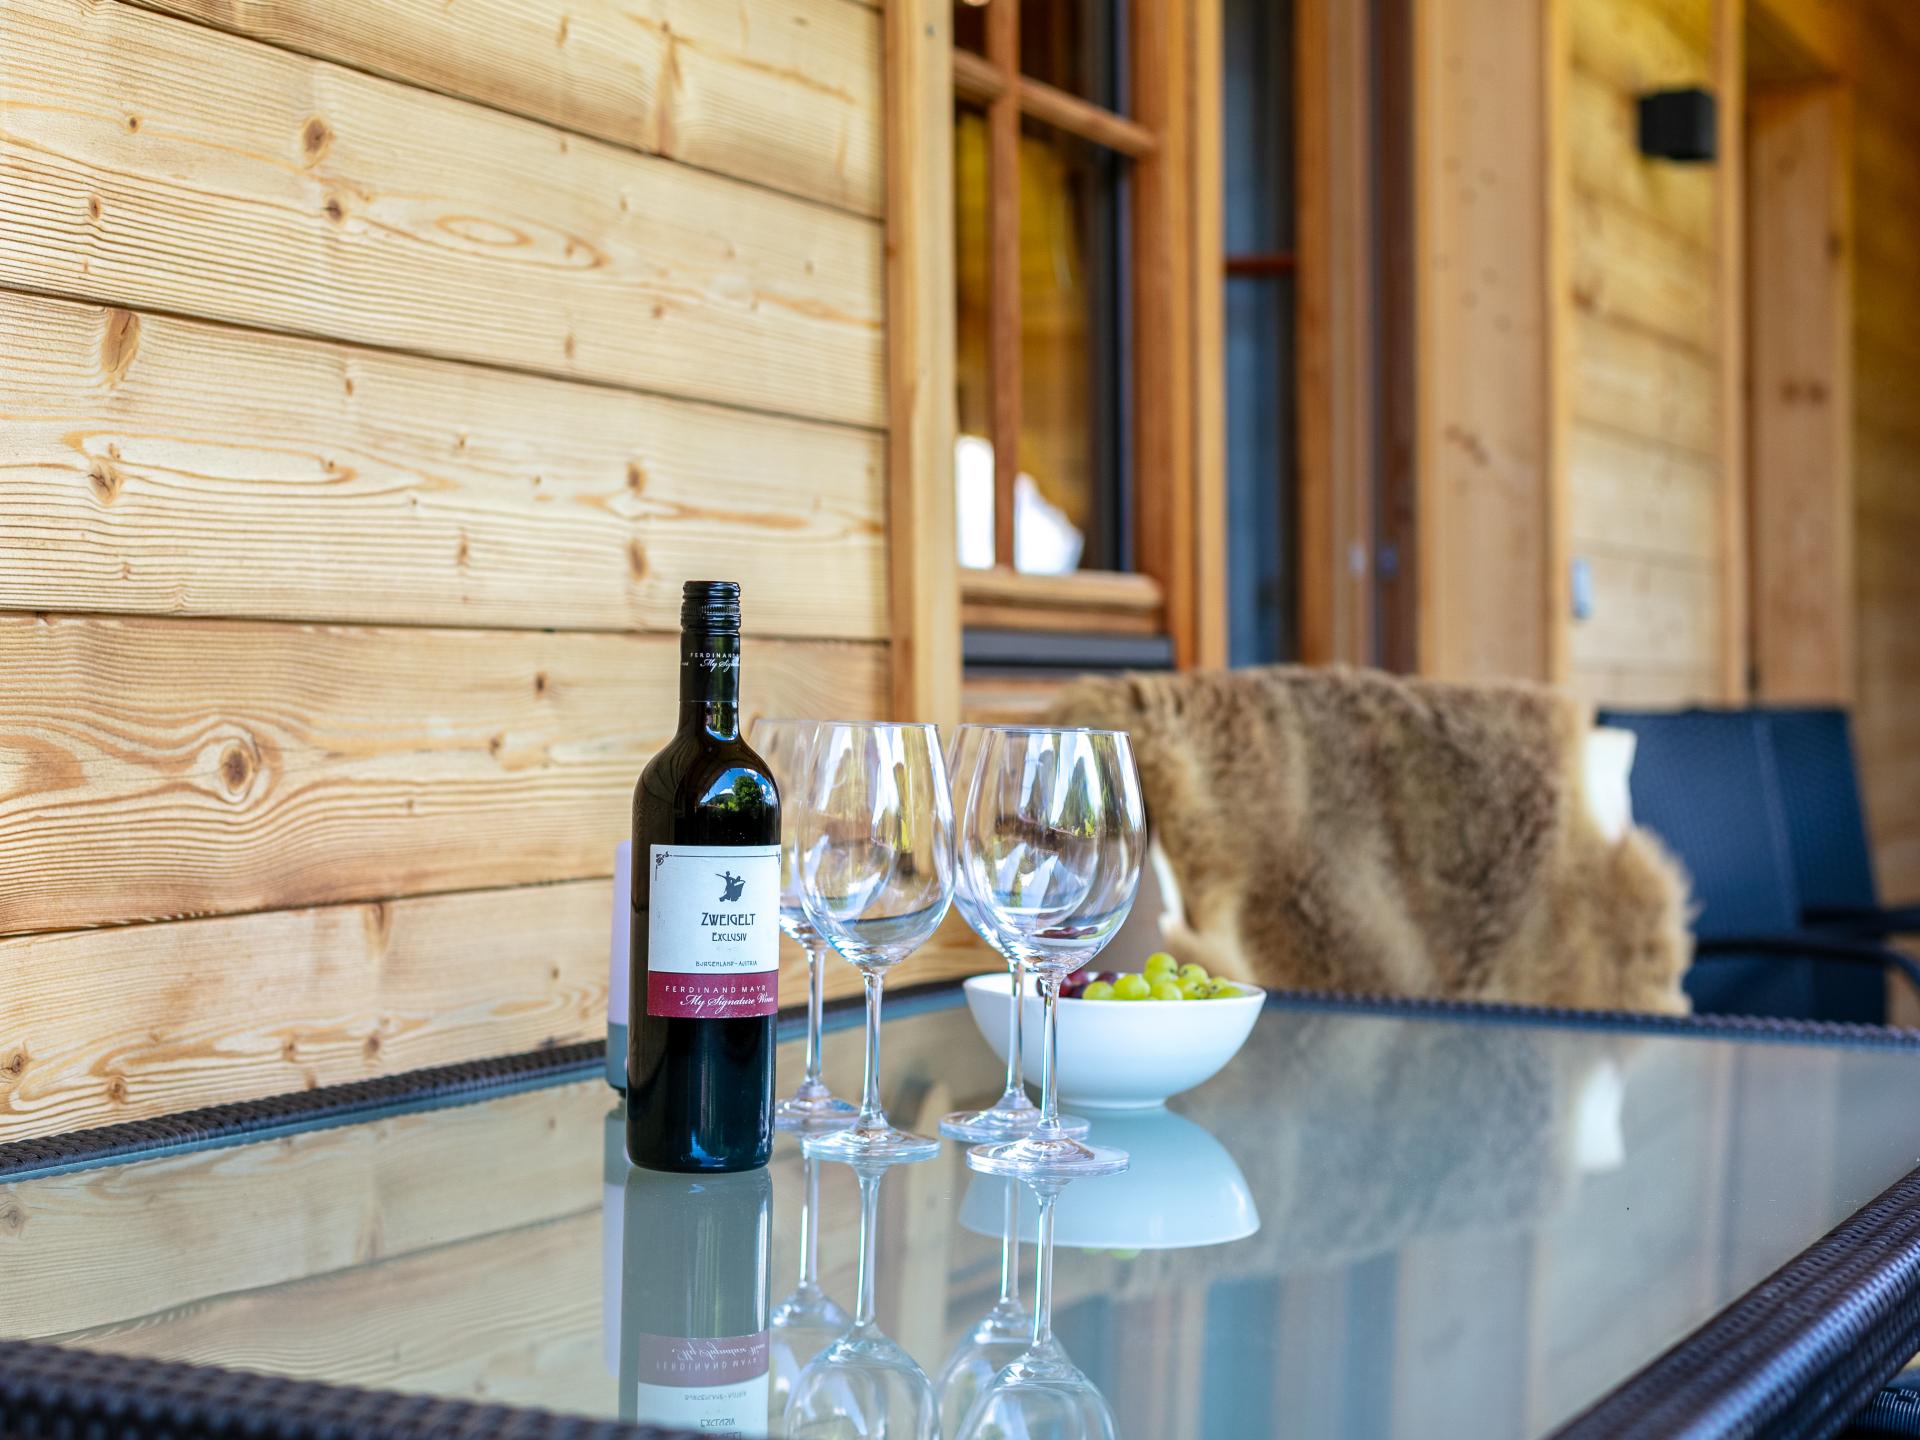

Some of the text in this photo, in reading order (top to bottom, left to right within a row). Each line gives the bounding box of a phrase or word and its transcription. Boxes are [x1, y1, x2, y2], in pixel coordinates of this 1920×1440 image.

[665, 985, 766, 994] FERDINAND MAYR
[680, 994, 704, 1013] My
[707, 994, 755, 1014] Signature
